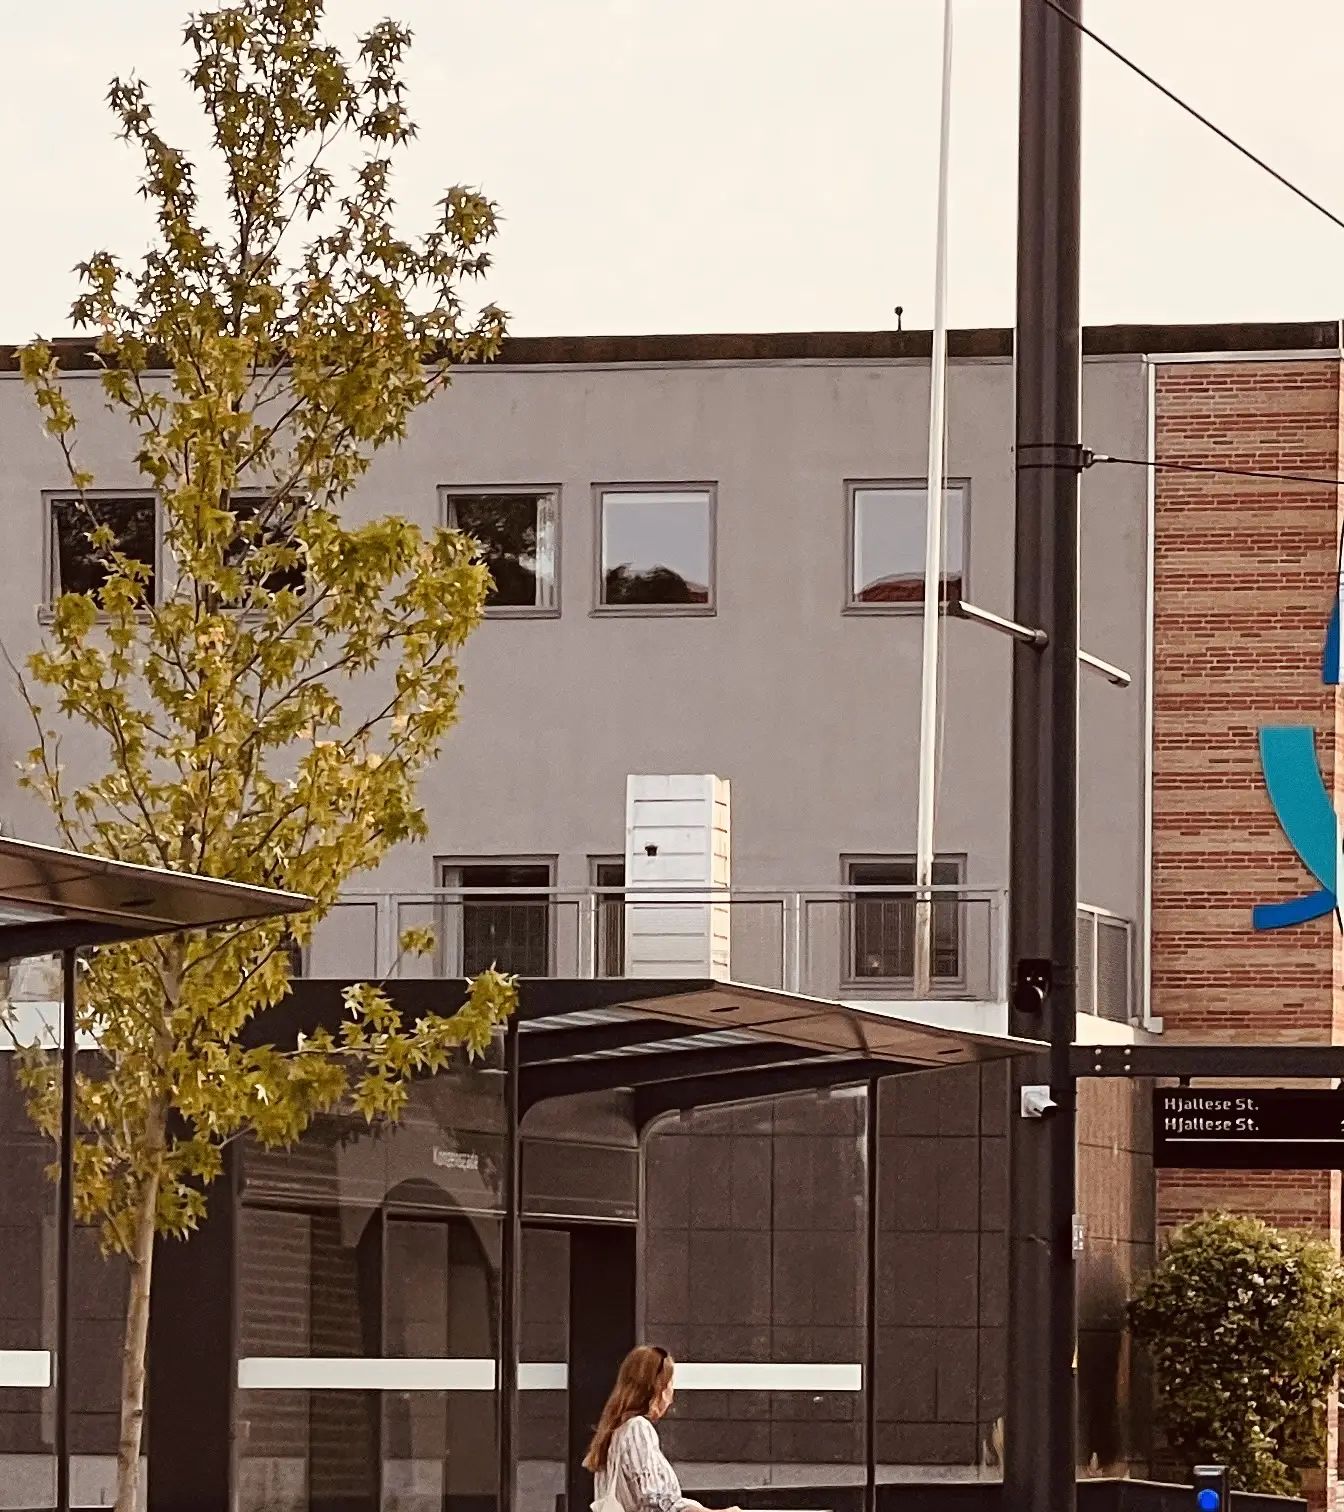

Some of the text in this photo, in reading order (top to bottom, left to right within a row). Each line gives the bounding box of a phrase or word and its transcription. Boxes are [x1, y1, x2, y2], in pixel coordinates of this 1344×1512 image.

[1164, 1098, 1232, 1113] Hjallese
[1235, 1098, 1259, 1111] St.
[1164, 1117, 1232, 1133] Hjallese
[1235, 1118, 1259, 1131] St.
